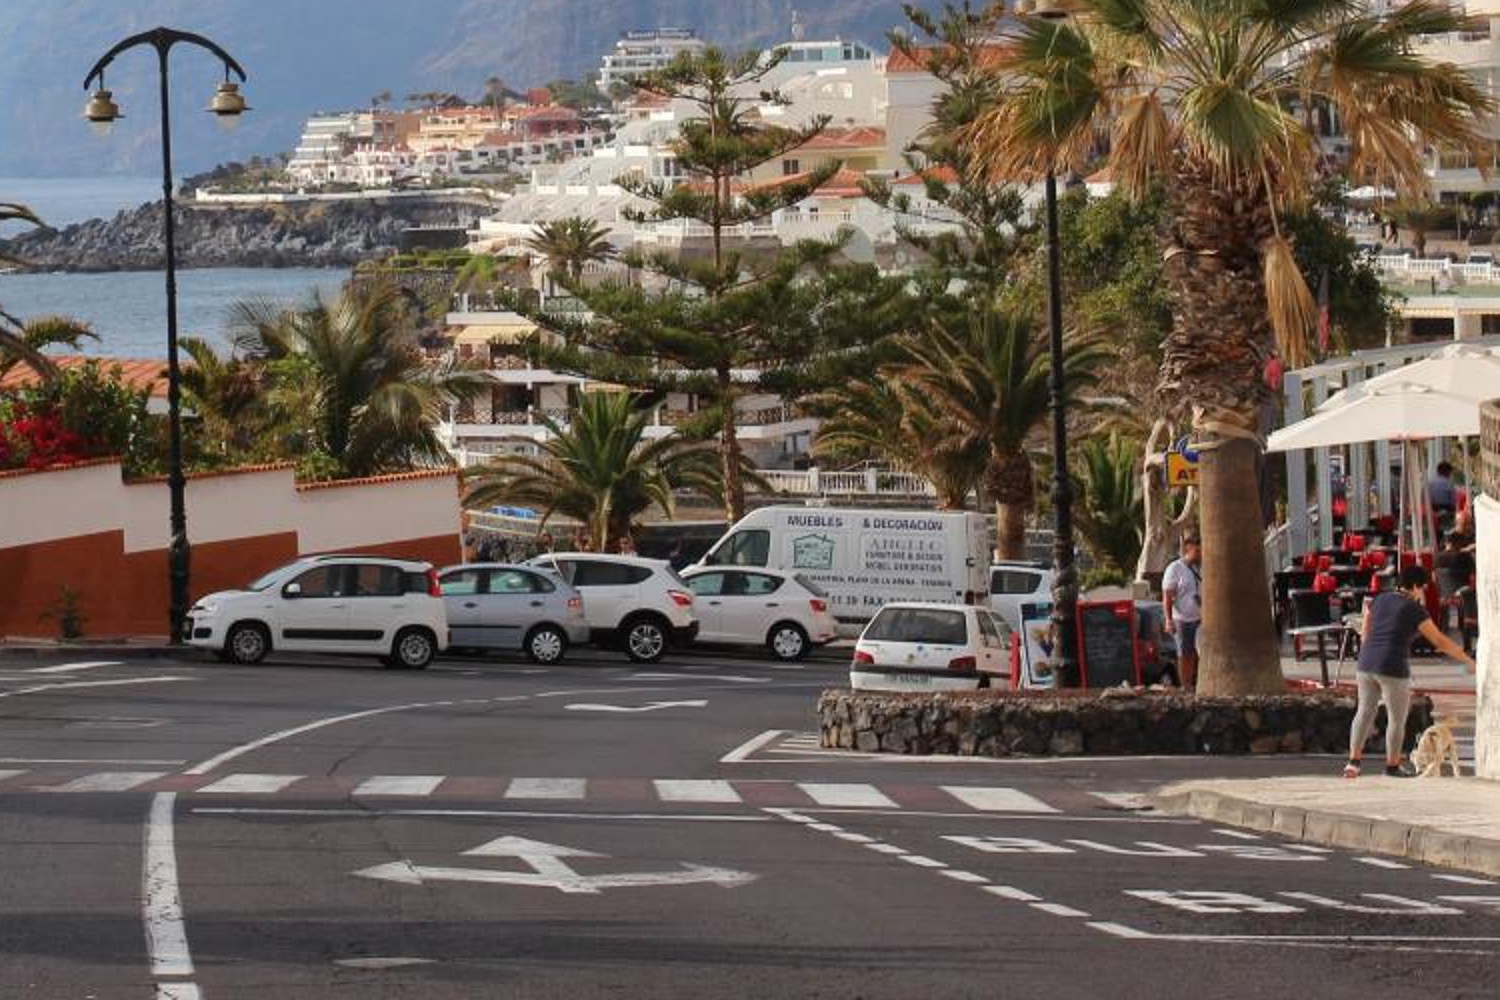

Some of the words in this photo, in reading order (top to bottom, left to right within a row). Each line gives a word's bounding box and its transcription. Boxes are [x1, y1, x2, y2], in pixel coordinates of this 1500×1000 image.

[1177, 469, 1199, 481] AT
[787, 515, 844, 528] MUEBLES
[863, 517, 871, 529] &
[938, 835, 1328, 861] BUS
